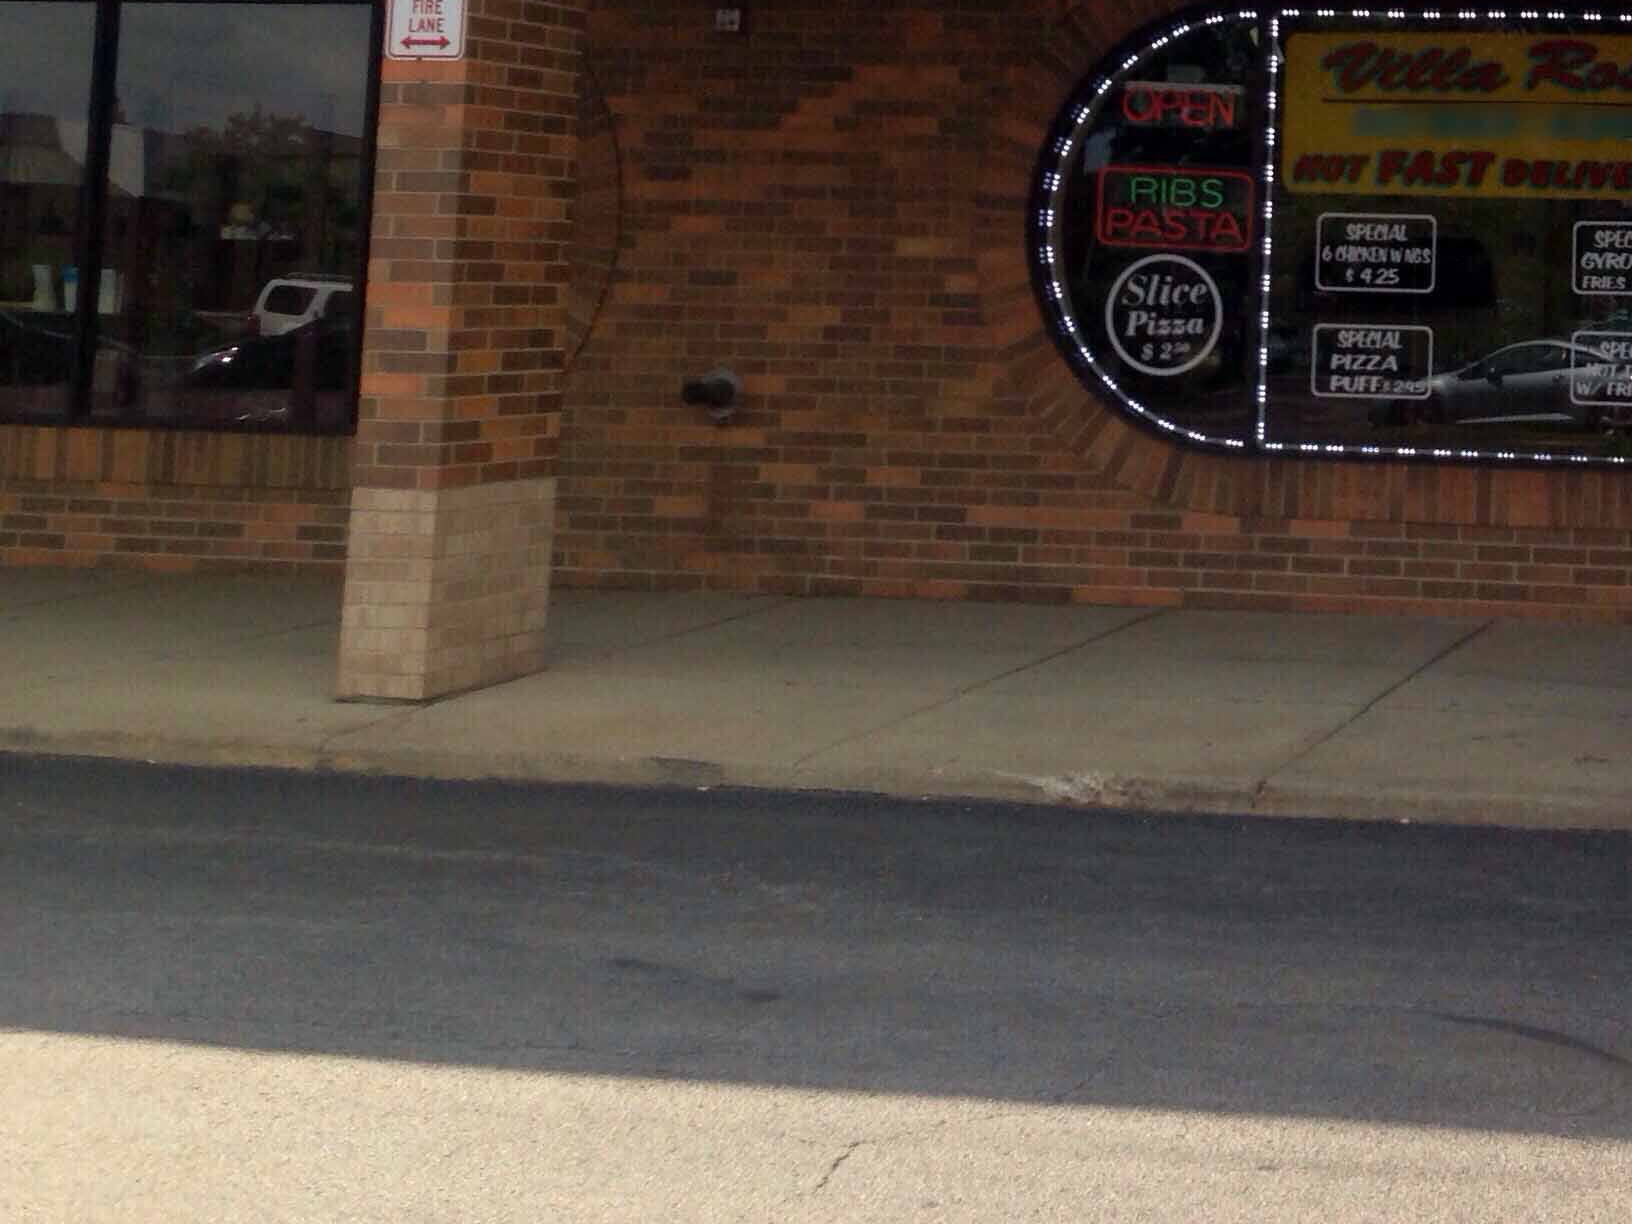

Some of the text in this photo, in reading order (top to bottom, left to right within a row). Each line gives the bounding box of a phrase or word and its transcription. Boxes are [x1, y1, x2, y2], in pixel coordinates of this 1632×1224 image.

[408, 17, 446, 33] LANE
[1321, 40, 1511, 94] Villa
[1120, 86, 1236, 127] OPEN
[1293, 153, 1371, 185] HOT
[1375, 149, 1496, 188] FAST
[1129, 176, 1225, 209] RIBS
[1104, 207, 1246, 244] PASTA
[1345, 222, 1409, 242] SPECIAL
[1321, 244, 1333, 263] 6
[1335, 244, 1389, 264] CHICKEN
[1121, 273, 1208, 306] Slice
[1582, 275, 1627, 290] FRIES
[1124, 309, 1205, 337] Pizza
[1337, 328, 1403, 350] SPECIAL
[1329, 353, 1398, 372] PIZZA
[1329, 374, 1383, 393] PUFF
